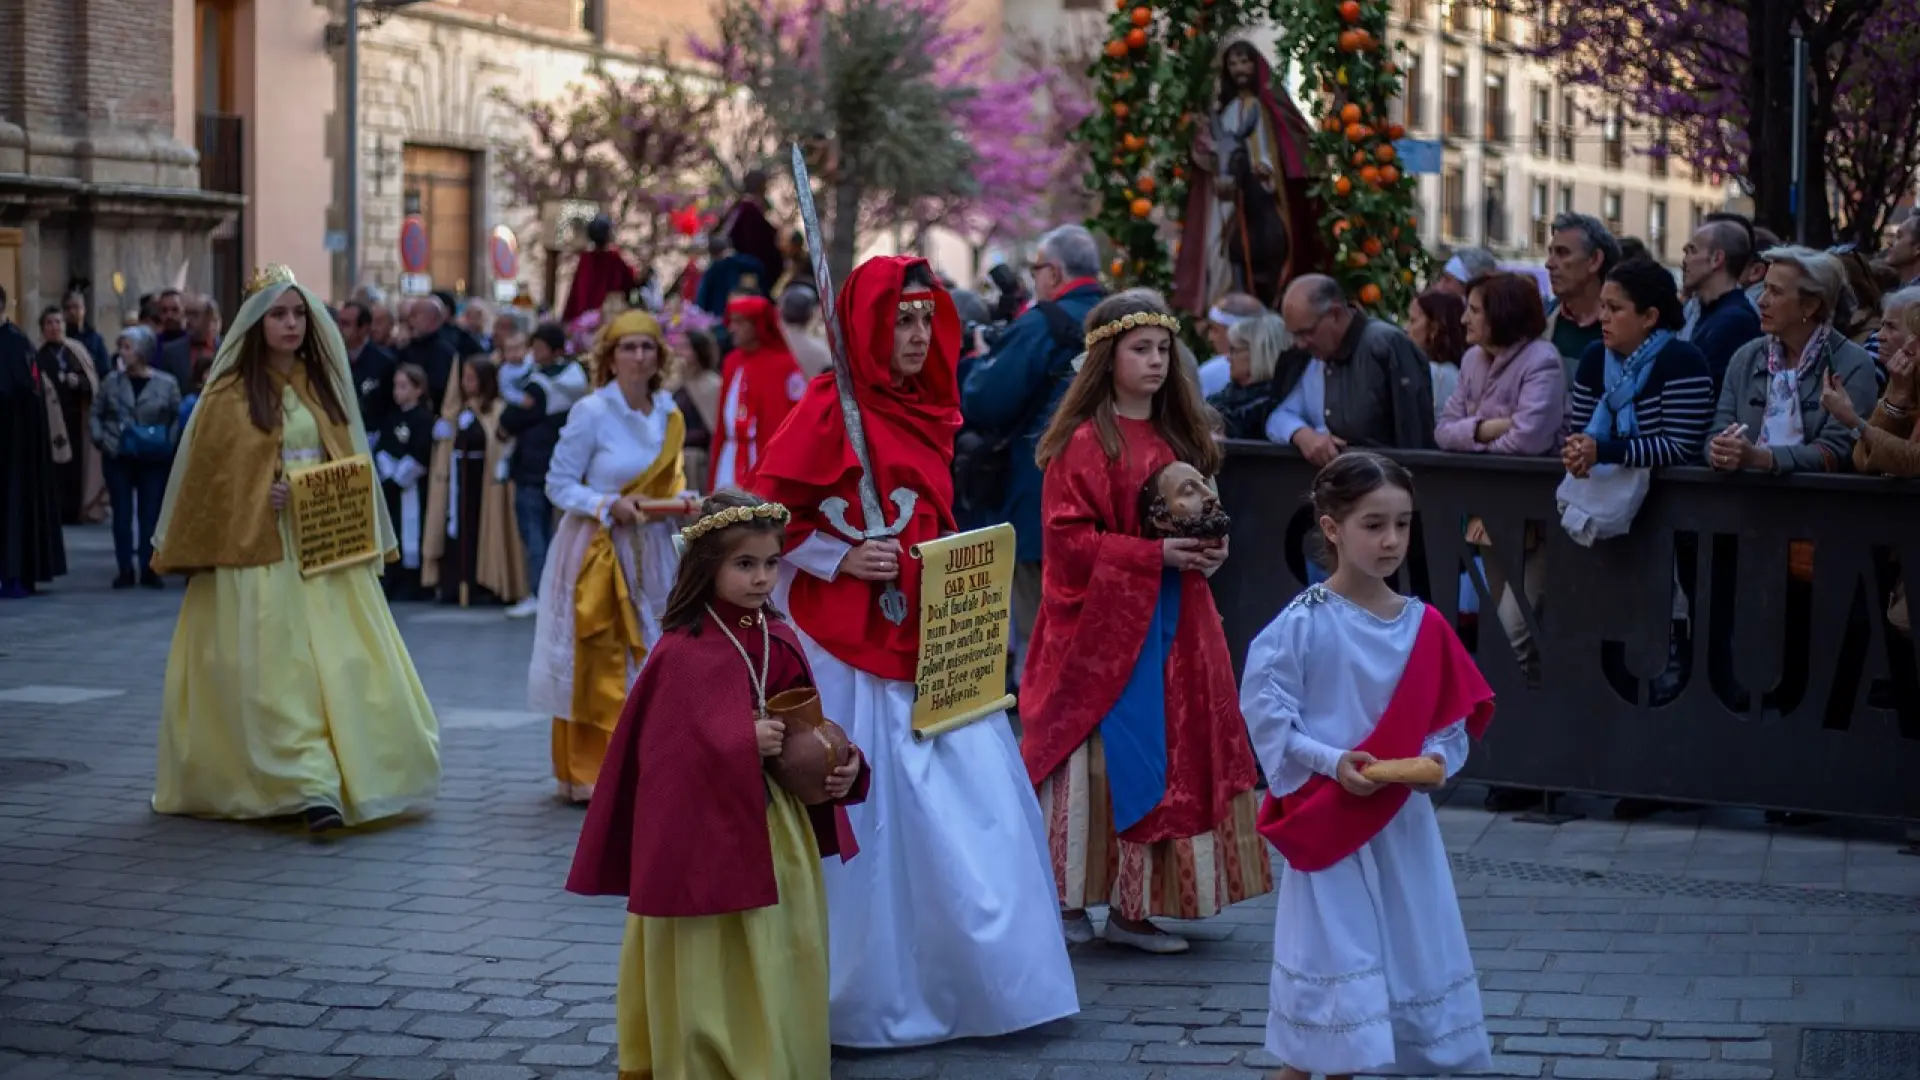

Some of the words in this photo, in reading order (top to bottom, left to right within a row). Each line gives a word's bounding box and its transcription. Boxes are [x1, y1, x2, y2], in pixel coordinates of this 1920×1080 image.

[944, 540, 994, 572] JUDITH
[950, 618, 973, 634] Deum
[947, 670, 968, 687] Ecce
[970, 659, 995, 682] caput
